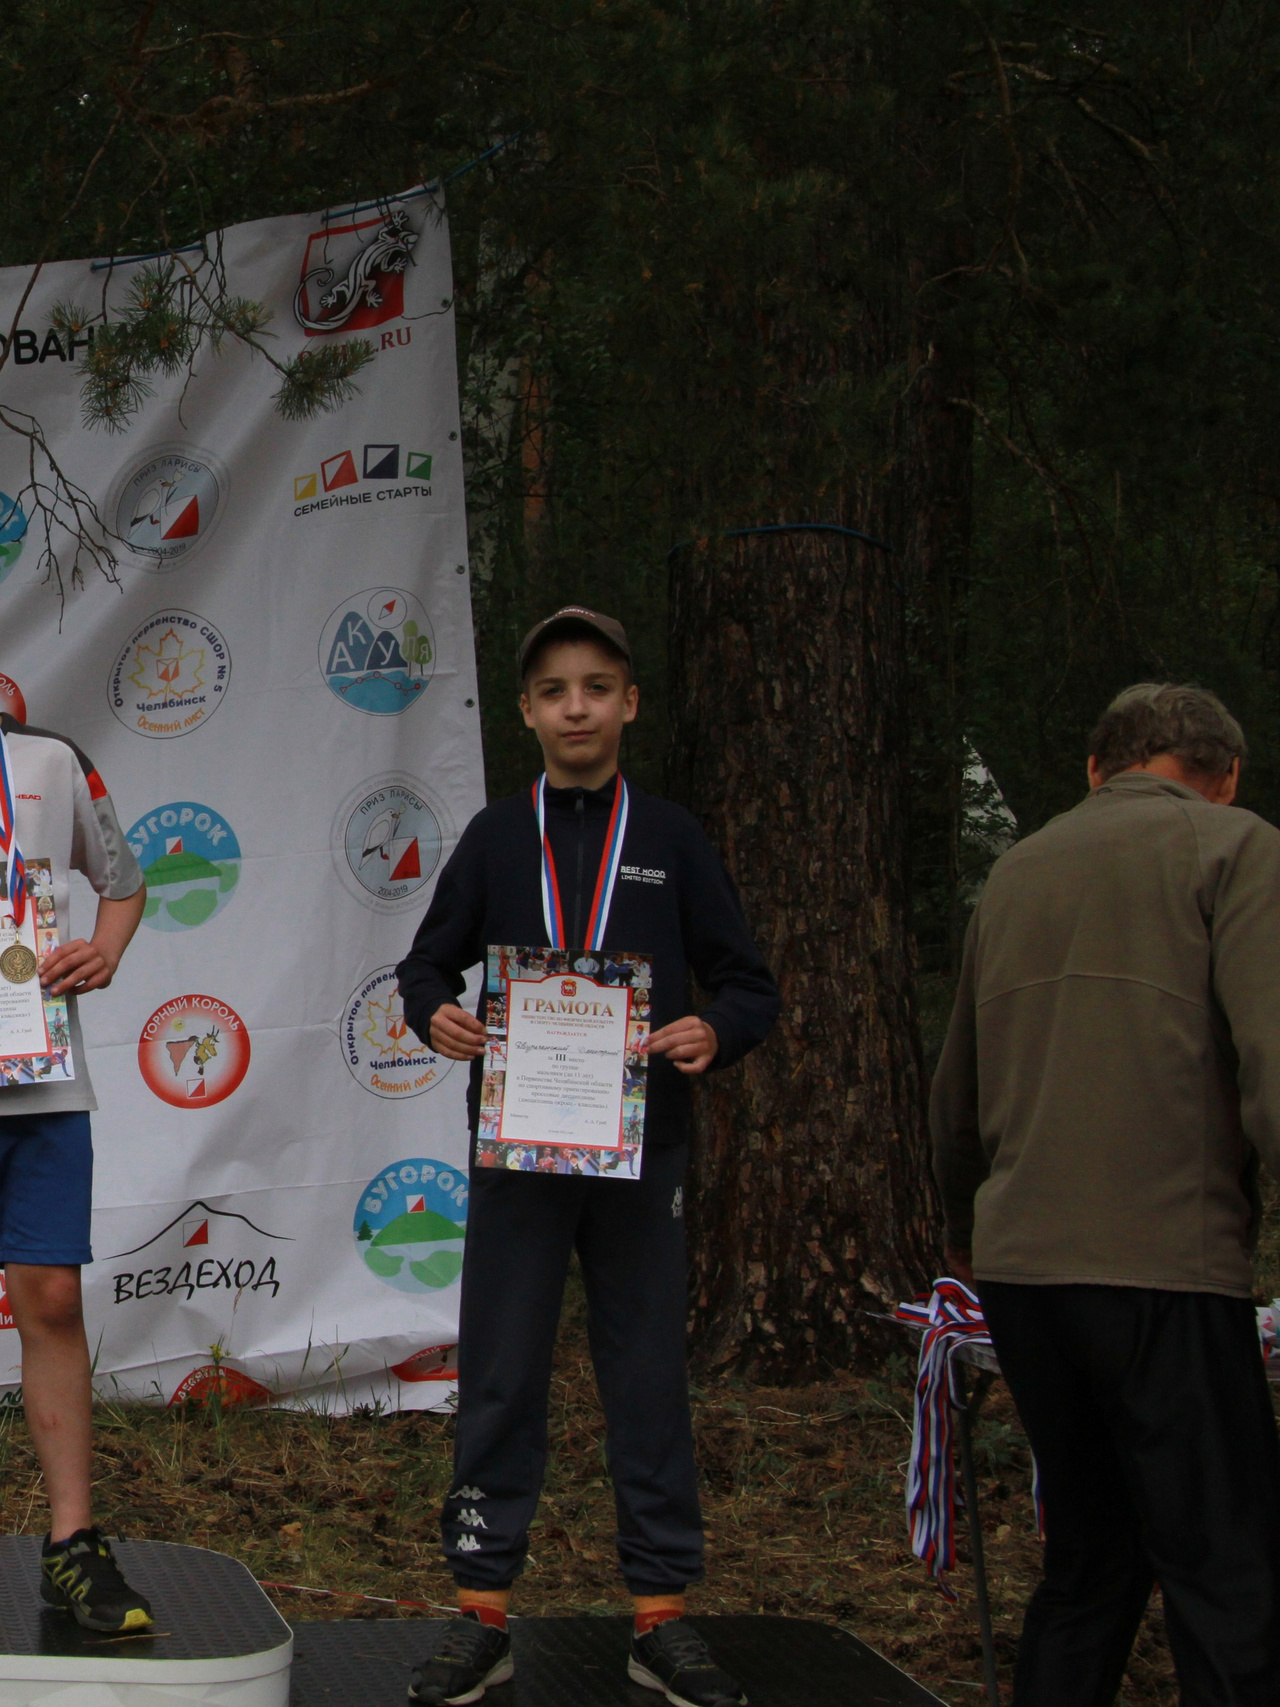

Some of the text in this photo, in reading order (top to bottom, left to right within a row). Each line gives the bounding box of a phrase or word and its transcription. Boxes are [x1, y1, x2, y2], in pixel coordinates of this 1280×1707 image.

[133, 459, 202, 487] ПРИЗ ЛАРИСЫ
[293, 486, 432, 517] СЕМЕЙНЫЕ СТАРТЫ
[113, 646, 131, 708] Открытое
[132, 616, 197, 644] первенство
[200, 626, 226, 661] СШОР
[213, 684, 223, 693] 5
[136, 695, 207, 712] Челябинск
[360, 793, 386, 816] ПРИЗ
[389, 789, 423, 812] ЛАРИСЫ
[128, 807, 228, 859] БУГОРОК
[620, 865, 666, 879] BEST MOOD
[377, 884, 409, 897] 2004-2019
[143, 996, 241, 1041] ГОРНЫЙ КОРОЛЬ
[346, 971, 400, 1066] Открытое первен
[522, 997, 614, 1017] ГРАМОТА
[370, 1056, 437, 1070] Челябинск
[556, 1053, 566, 1061] III
[371, 1073, 412, 1093] Осенний
[363, 1165, 469, 1214] БУГОРОК
[113, 1256, 280, 1304] ВЕЗДЕХОД
